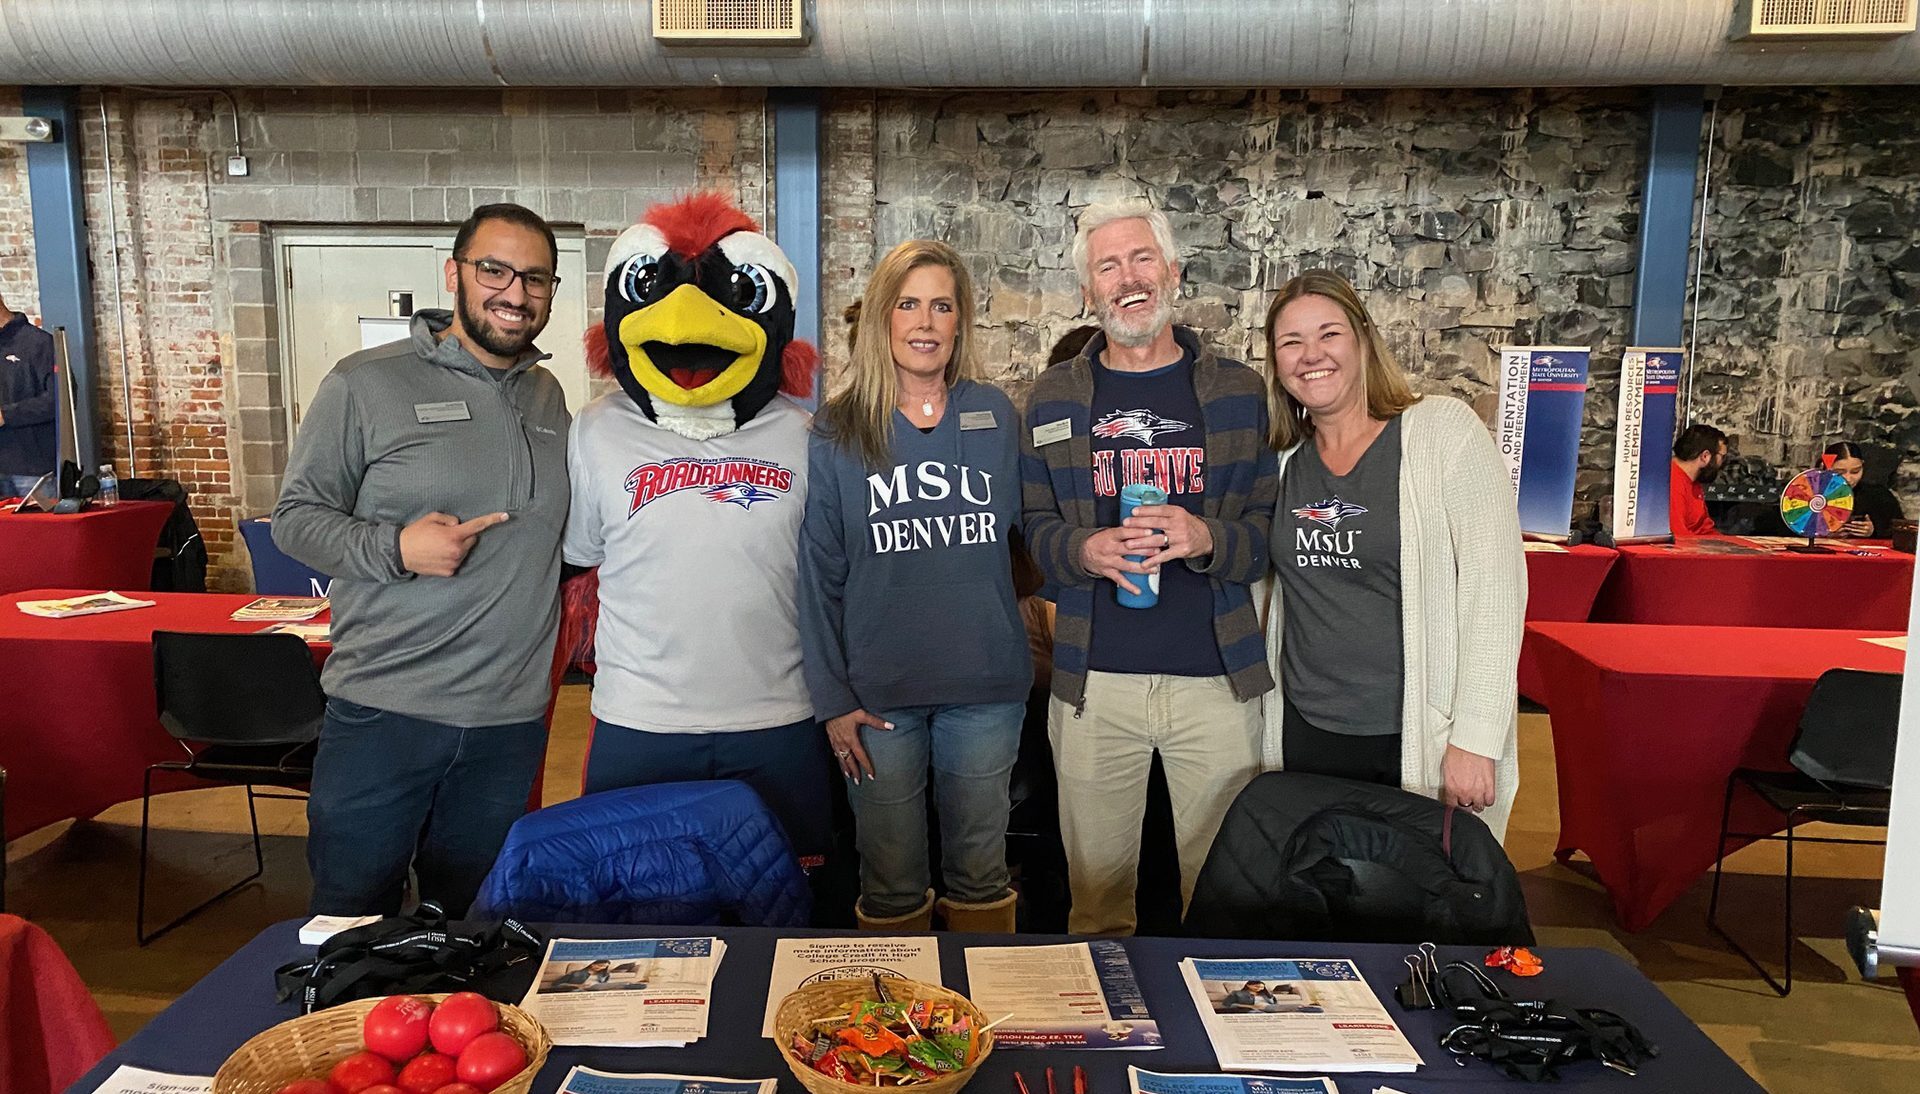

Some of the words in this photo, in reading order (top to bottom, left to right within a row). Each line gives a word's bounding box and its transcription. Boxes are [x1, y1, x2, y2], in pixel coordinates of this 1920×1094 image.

[1502, 355, 1520, 454] ORIENTATION
[1515, 356, 1529, 437] REENGAGEMENT
[1625, 357, 1635, 421] RESOURCES
[1631, 357, 1645, 458] EMPLOYMENT
[1513, 440, 1521, 462] AND
[1623, 424, 1632, 463] HUMAN
[625, 461, 792, 519] ROADRUNNERS
[866, 461, 992, 517] MSU
[1626, 463, 1638, 527] STUDENT
[871, 512, 997, 553] DENVER
[1296, 554, 1362, 569] DENVER
[147, 1083, 200, 1092] Sign-up
